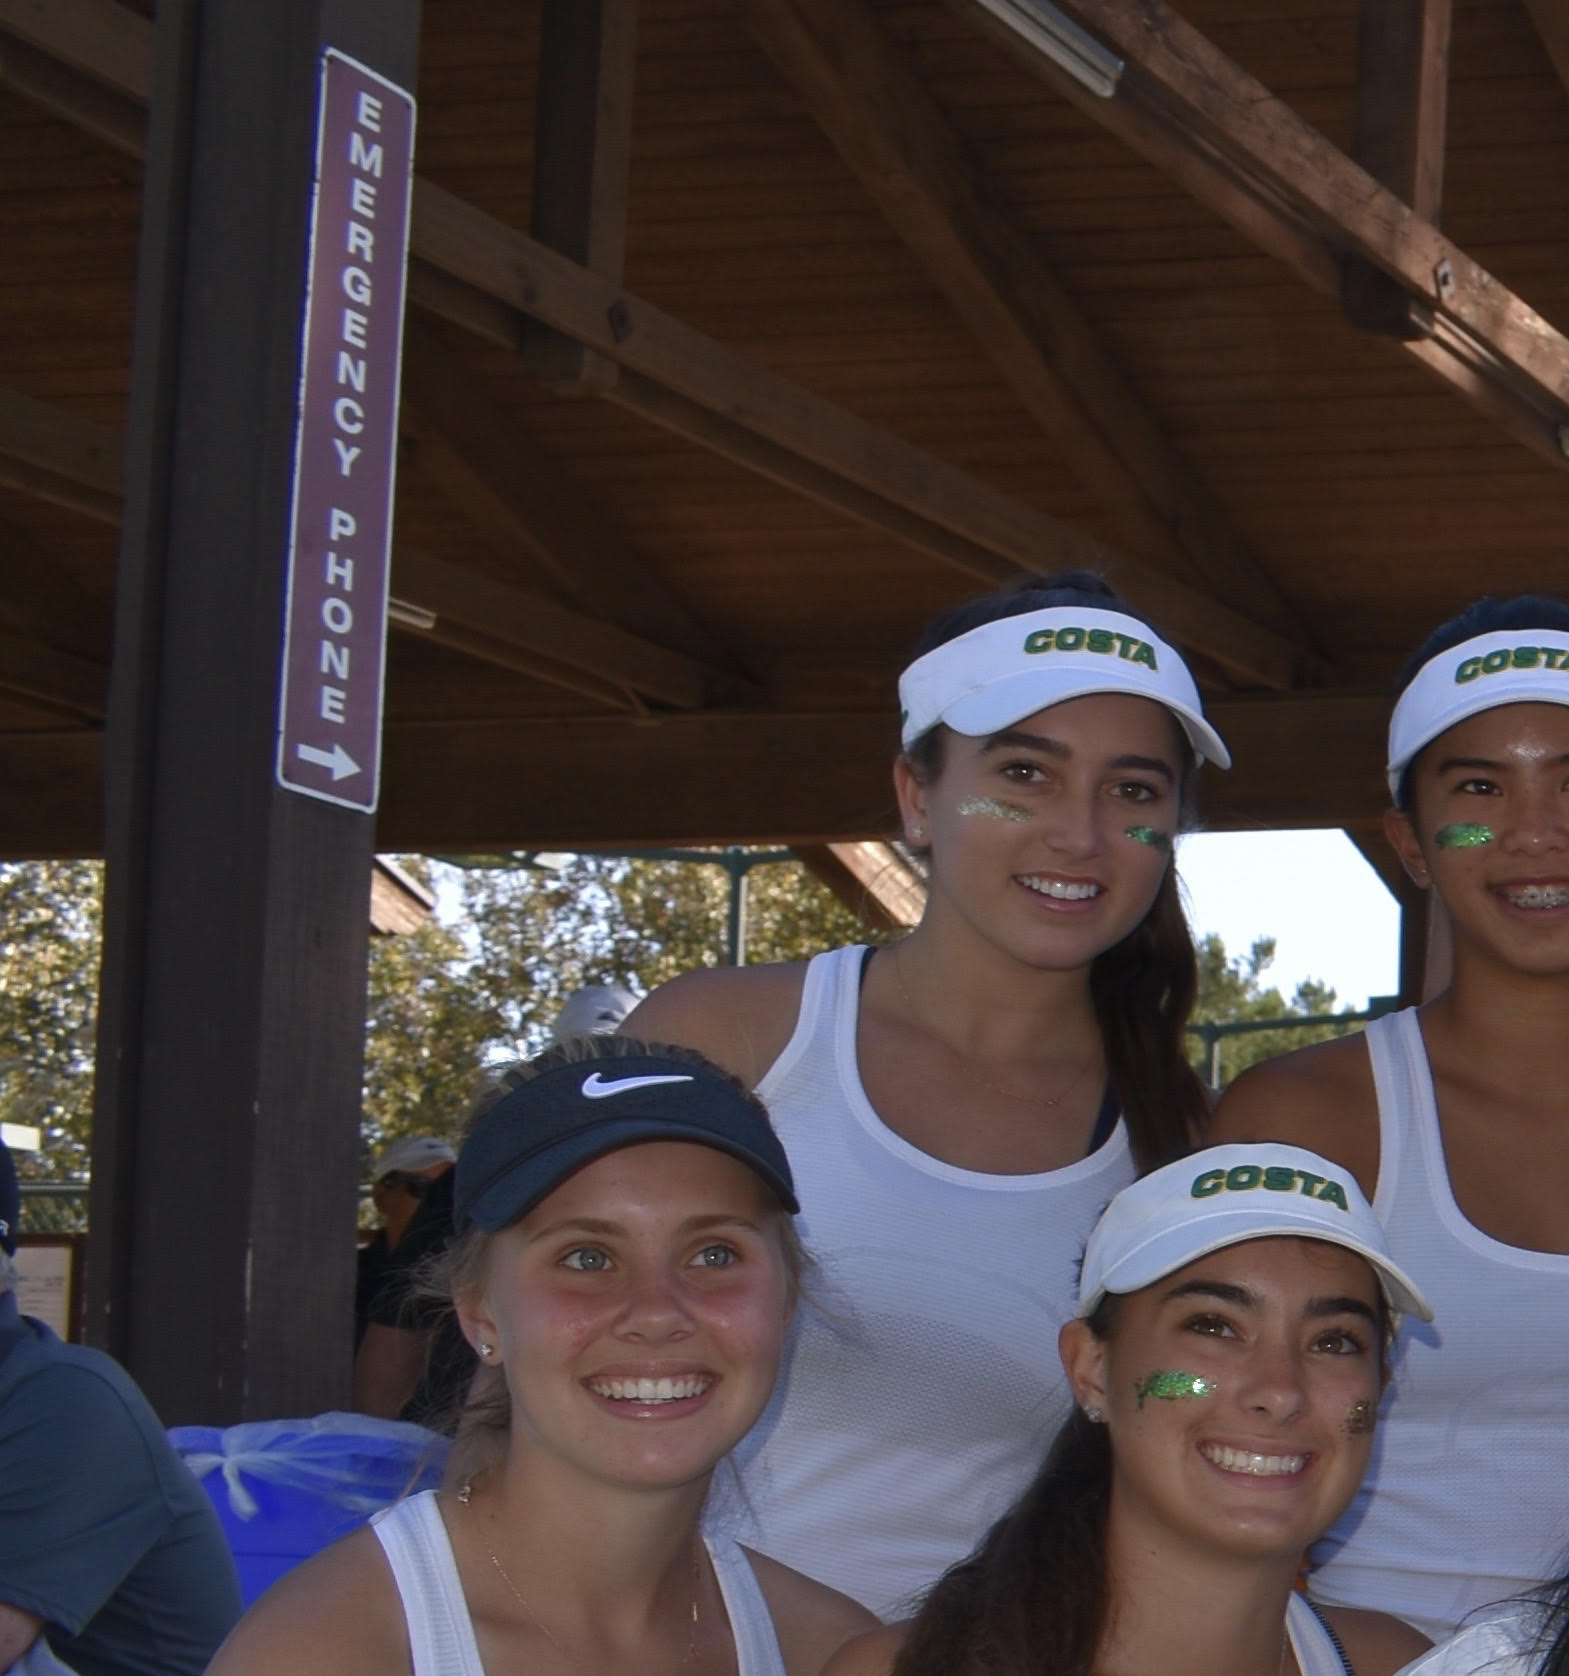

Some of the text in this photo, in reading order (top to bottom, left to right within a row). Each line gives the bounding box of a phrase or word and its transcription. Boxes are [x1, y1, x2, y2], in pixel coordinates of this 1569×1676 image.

[322, 90, 383, 726] EMERGENCY PHONE
[1024, 627, 1160, 673] COSTA
[1191, 1165, 1351, 1215] COSTA
